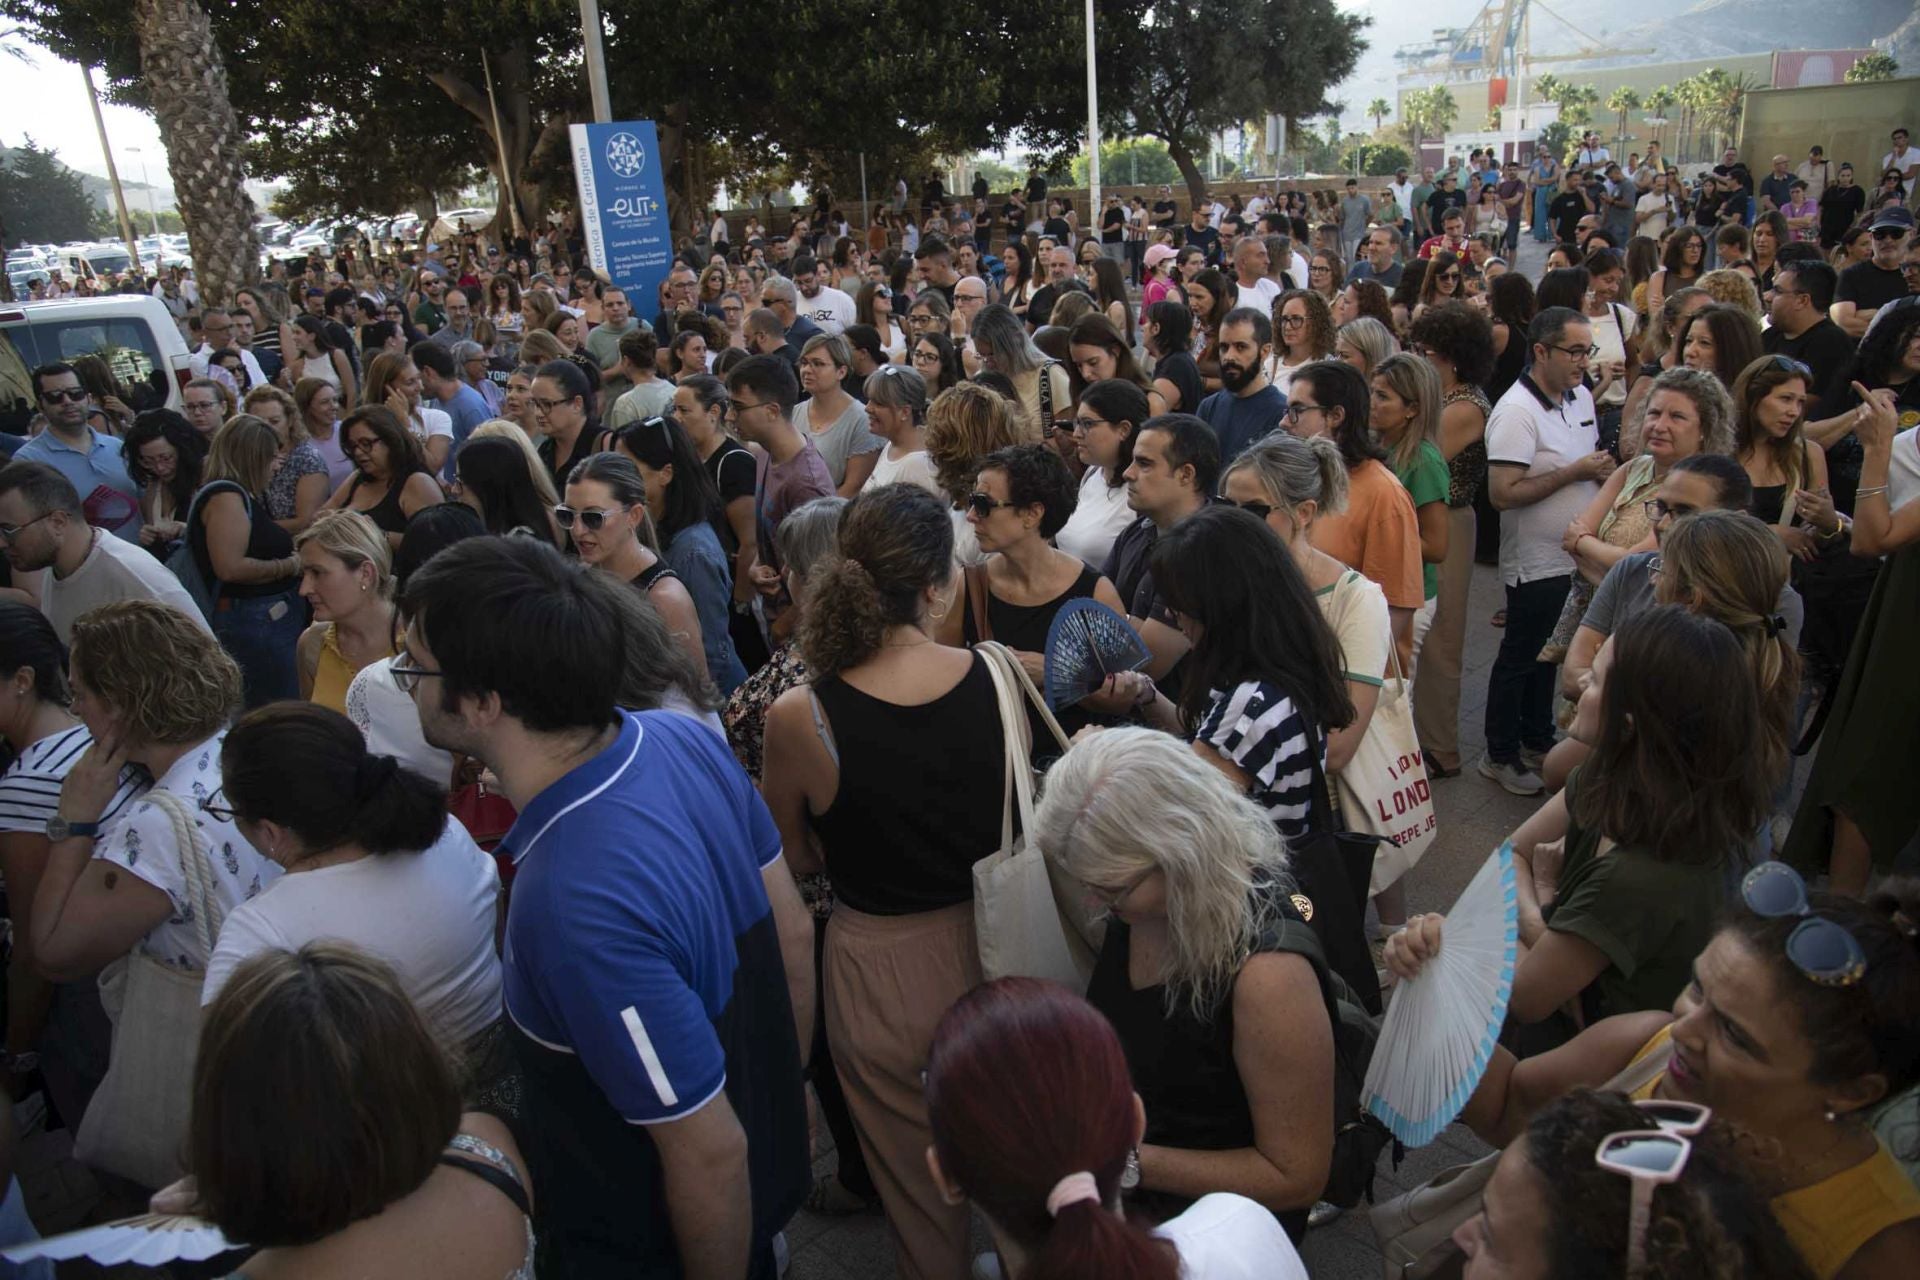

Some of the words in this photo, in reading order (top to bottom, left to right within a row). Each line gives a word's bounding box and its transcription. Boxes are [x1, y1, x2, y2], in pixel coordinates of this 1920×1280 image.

[579, 147, 594, 205] Cartagena
[587, 208, 597, 223] de
[1041, 375, 1049, 403] LOLA
[1387, 766, 1398, 781] I
[1377, 779, 1430, 822] LOND
[1392, 823, 1422, 846] PEPE
